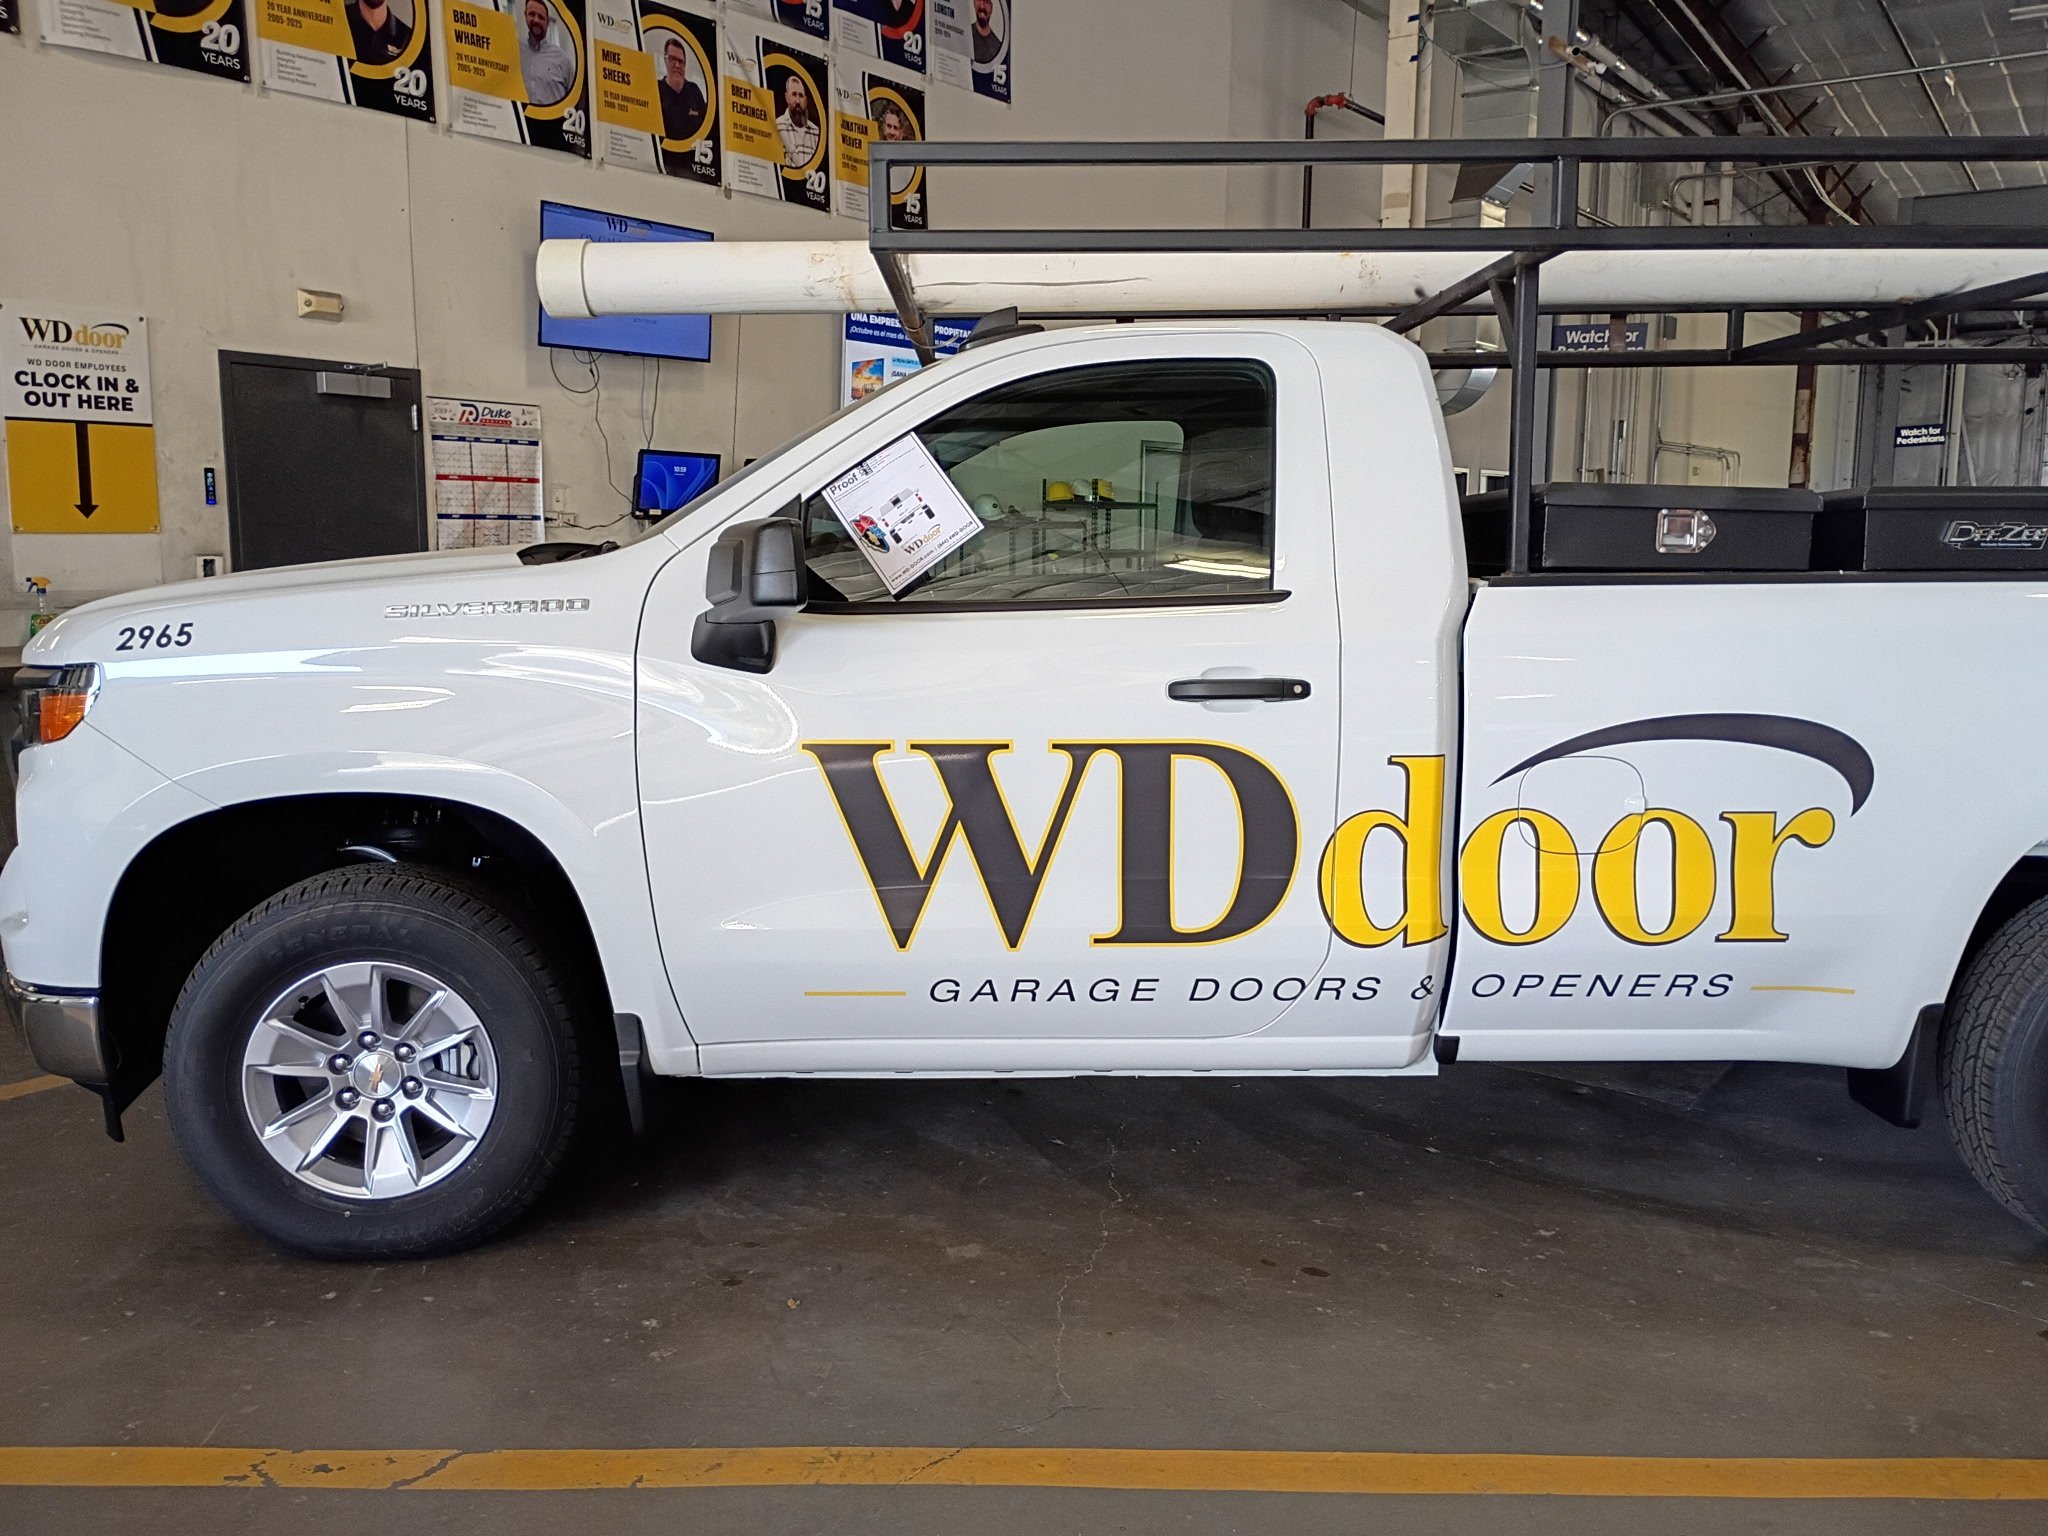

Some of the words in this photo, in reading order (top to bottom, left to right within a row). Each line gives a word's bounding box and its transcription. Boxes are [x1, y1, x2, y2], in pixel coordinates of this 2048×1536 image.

[266, 3, 275, 11] 20
[276, 4, 292, 15] YEAR
[293, 8, 334, 25] ANNIVERSARY
[453, 9, 477, 28] BRAD
[803, 0, 822, 18] 15
[803, 16, 824, 31] YEARS
[200, 20, 240, 55] 20
[454, 29, 491, 51] WHARFF
[903, 30, 922, 55] 20
[201, 50, 241, 70] YEARS
[456, 52, 463, 61] 20
[464, 54, 477, 64] YEAR
[478, 57, 510, 74] ANNIVERSARY
[602, 48, 622, 66] MIKE
[904, 52, 922, 66] YEARS
[393, 66, 427, 98] 20
[602, 67, 631, 86] SHEEKS
[992, 64, 1007, 85] 15
[731, 84, 752, 101] BRENT
[991, 84, 1007, 95] YEARS
[394, 94, 428, 111] YEARS
[609, 91, 620, 101] YEAR
[620, 94, 649, 108] ANNIVERSARY
[562, 107, 586, 135] 20
[731, 101, 768, 122] FLICKINGER
[840, 118, 869, 137] JONATHAN
[563, 132, 586, 148] YEARS
[841, 133, 862, 150] WEAVER
[692, 140, 713, 165] 15
[691, 163, 715, 177] YEARS
[805, 169, 826, 194] 20
[806, 191, 826, 204] YEARS
[904, 193, 921, 214] 15
[904, 214, 922, 225] YEARS
[850, 312, 868, 323] UNA
[27, 358, 42, 366] WD
[45, 360, 71, 368] DOOR
[75, 361, 127, 373] EMPLOYEES
[14, 370, 92, 391] CLOCK
[97, 376, 119, 392] IN
[125, 378, 139, 394] &
[24, 390, 71, 409] OUT
[77, 394, 134, 412] HERE
[1896, 435, 1945, 445] Pedestrians
[1900, 428, 1928, 436] Watch
[1929, 427, 1941, 435] for
[829, 472, 859, 496] Proof
[384, 598, 590, 619] SILVERADO
[115, 622, 193, 651] 2965
[930, 978, 1160, 1002] GARAGE
[1189, 976, 1381, 1001] DOORS
[1410, 975, 1434, 1000] &
[1471, 974, 1734, 997] OPENERS
